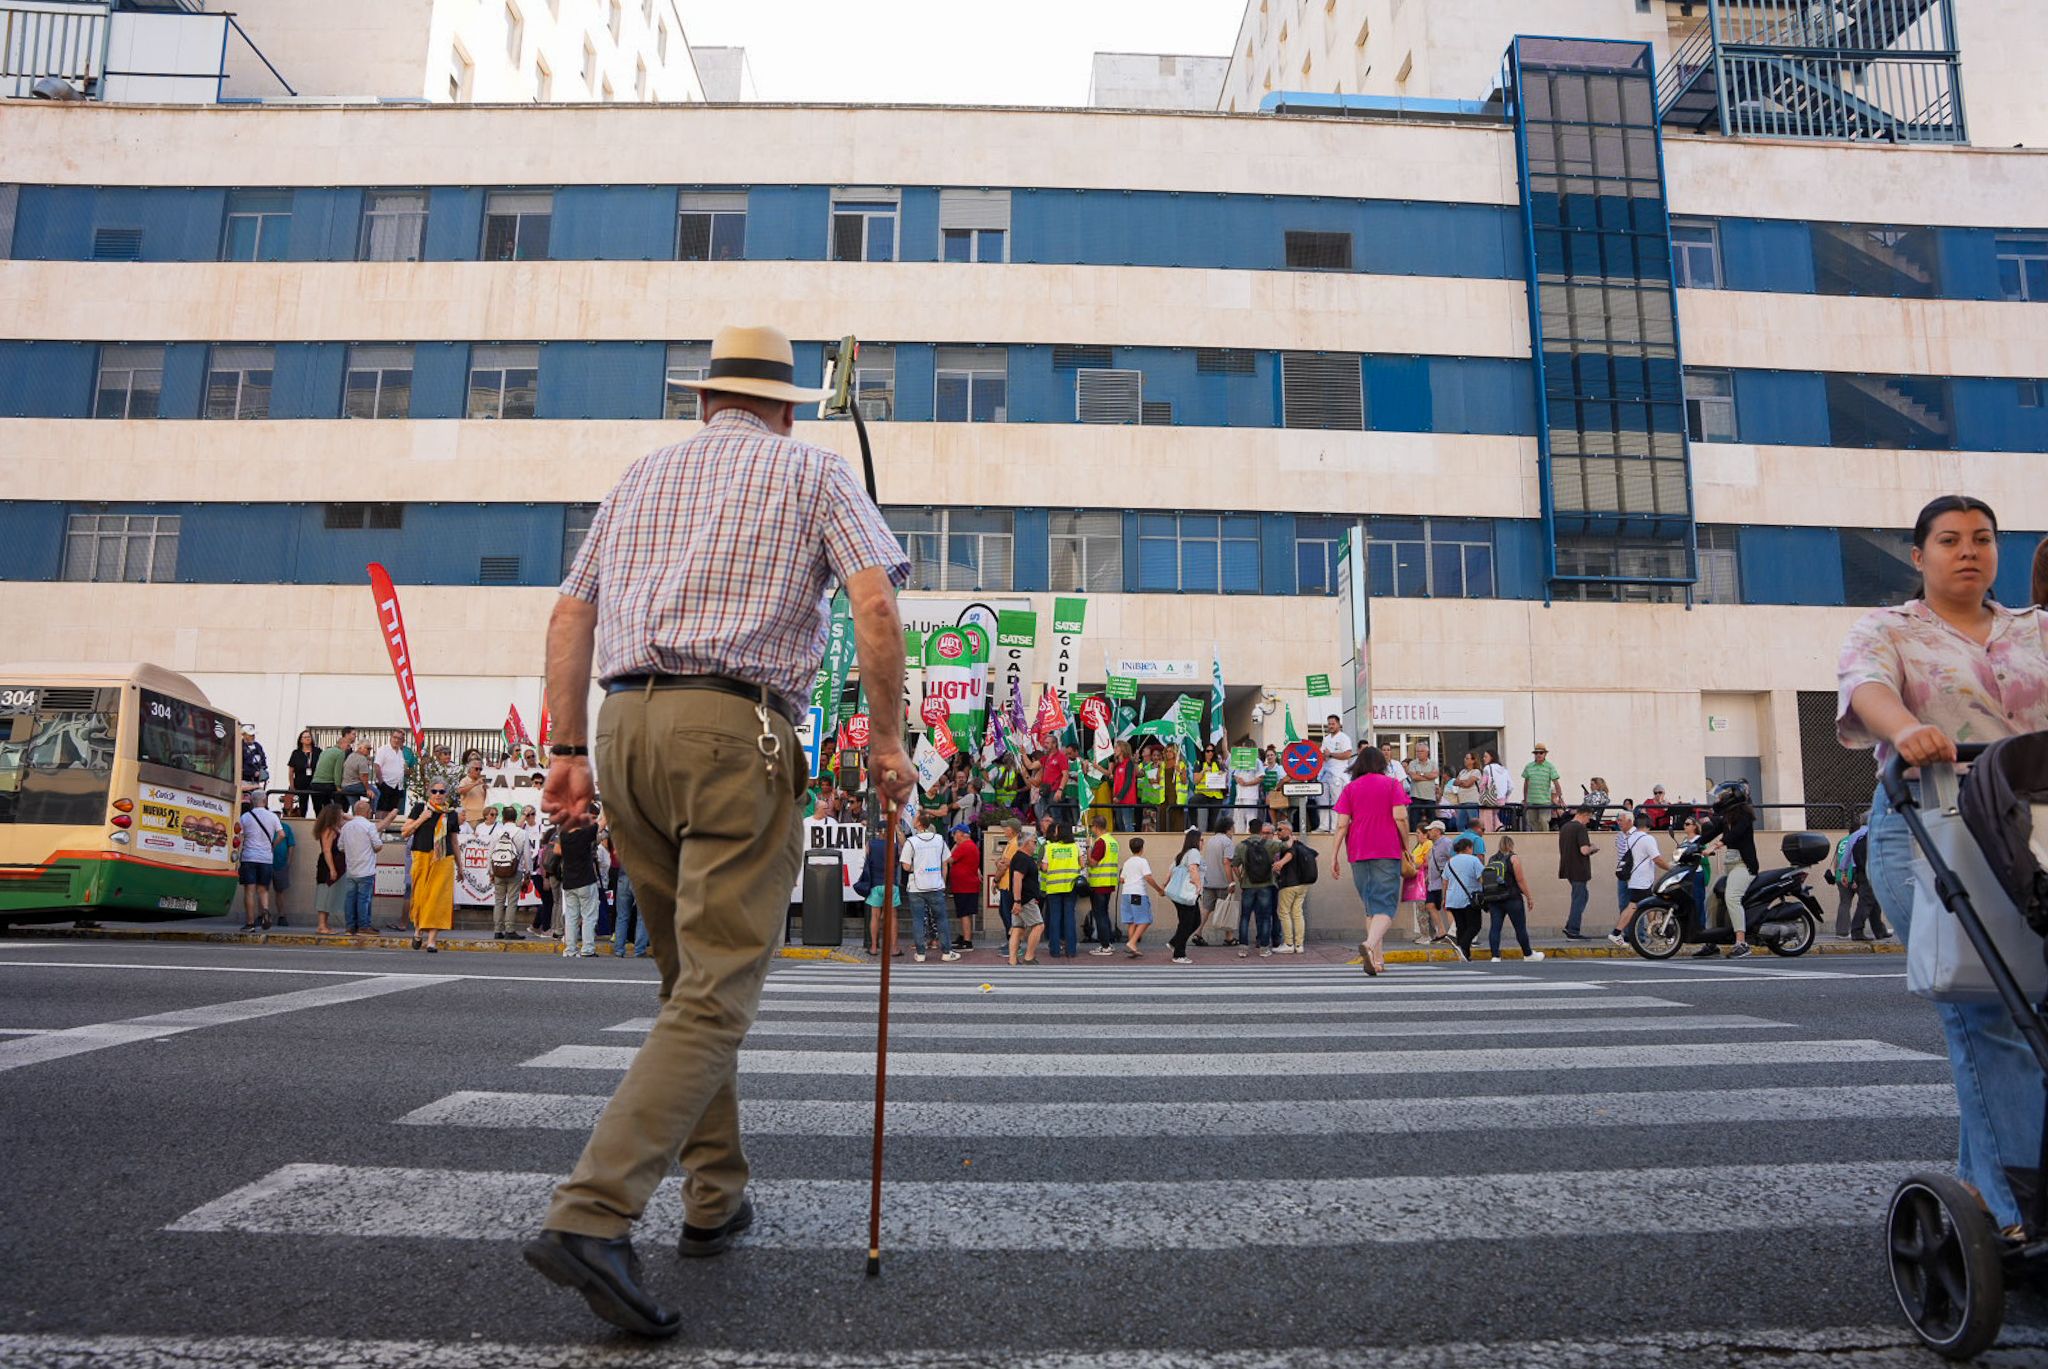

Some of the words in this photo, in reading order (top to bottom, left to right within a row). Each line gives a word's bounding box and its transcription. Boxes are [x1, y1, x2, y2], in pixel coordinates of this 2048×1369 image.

[1055, 621, 1082, 631] SATSE
[940, 637, 960, 649] UGT
[999, 634, 1033, 645] SATSE
[1, 690, 35, 706] 304
[931, 681, 969, 700] UGT
[151, 702, 170, 719] 304
[924, 697, 945, 711] UGT
[1372, 701, 1439, 720] CAFETERÍA
[811, 826, 863, 849] BLAN
